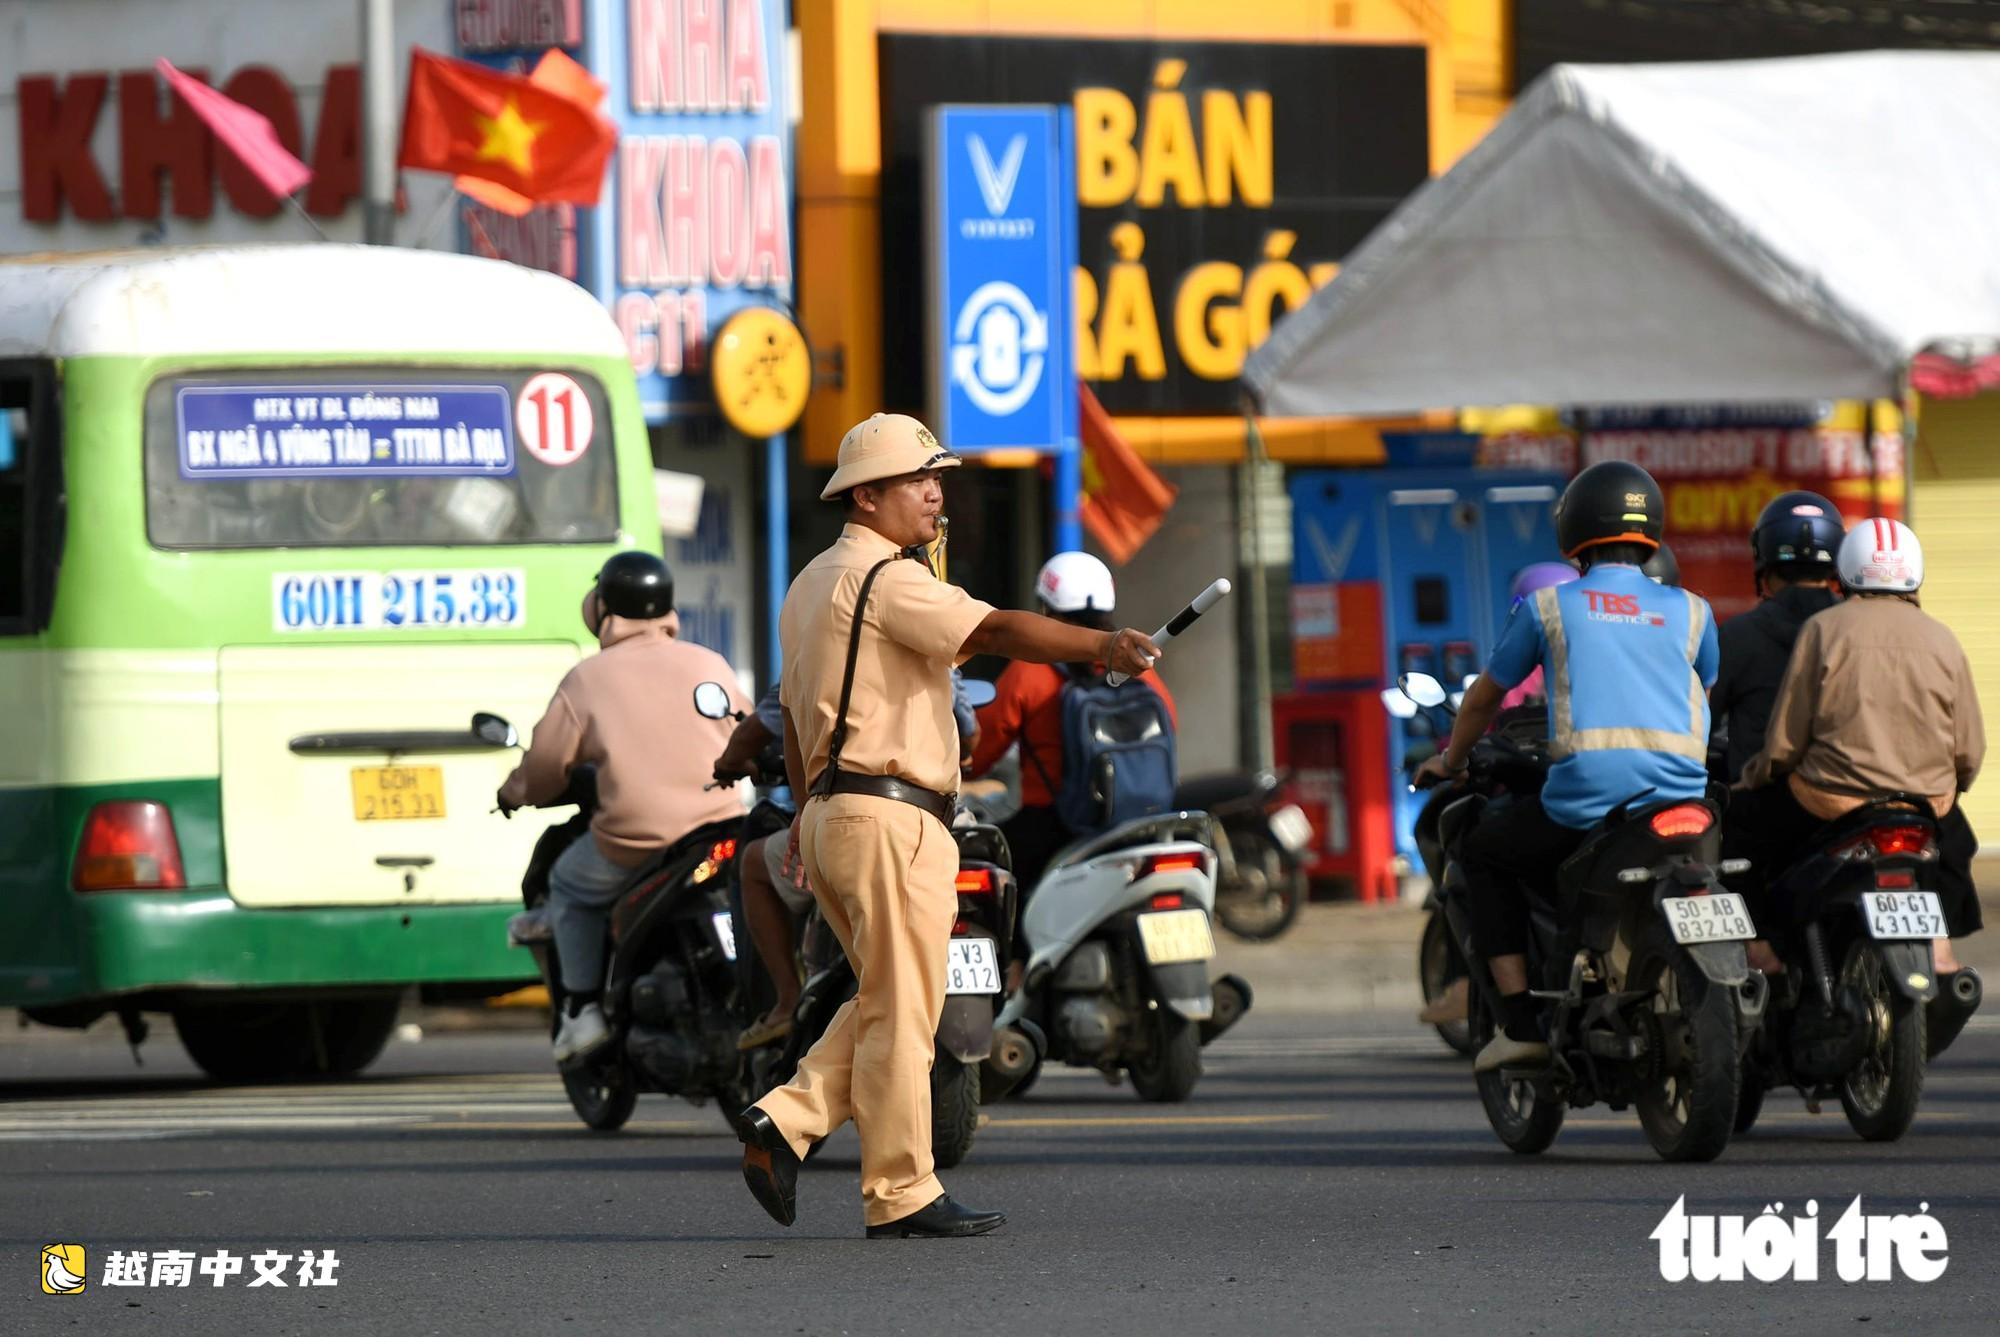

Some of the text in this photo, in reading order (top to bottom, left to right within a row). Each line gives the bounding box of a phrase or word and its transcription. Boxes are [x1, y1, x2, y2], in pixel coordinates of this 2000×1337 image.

[1074, 59, 1274, 208] BÁN
[621, 134, 791, 287] KHOA
[1174, 229, 1341, 381] GÓ
[404, 397, 440, 420] NAI
[528, 384, 575, 452] 11
[263, 430, 278, 465] 4
[332, 422, 371, 464] TÀU
[281, 573, 518, 626] 60H 215.33
[1581, 588, 1642, 615] TBS
[1588, 611, 1650, 625] LOGISTICS
[1675, 897, 1735, 918] 50-AB
[1677, 917, 1748, 939] 832.48
[1875, 914, 1941, 934] 431.57
[945, 967, 994, 988] 8.12
